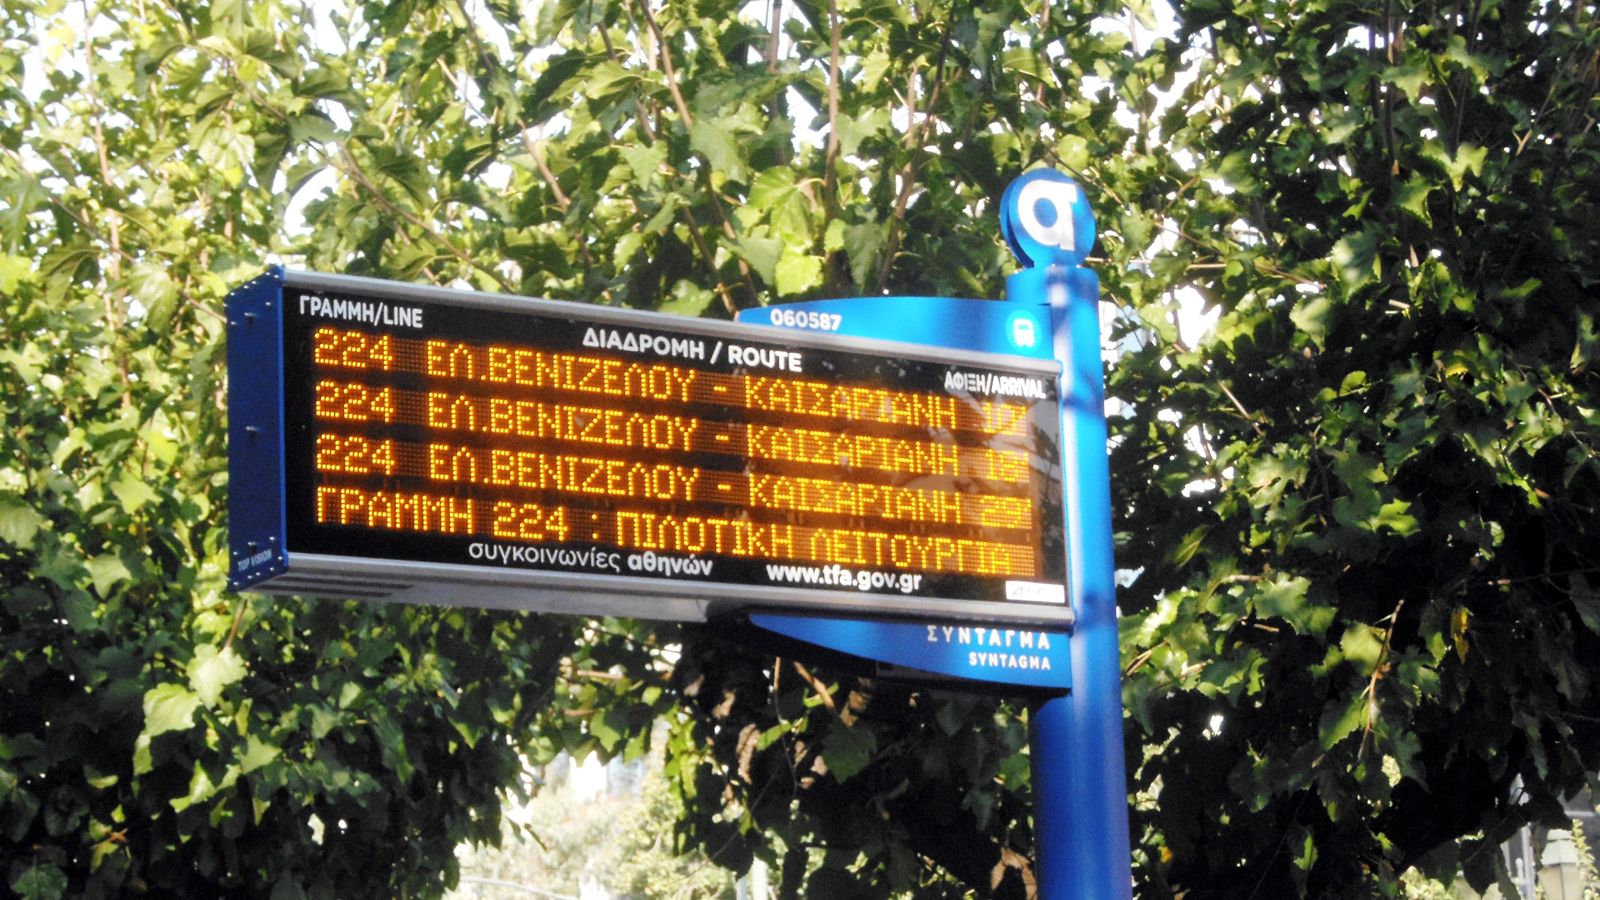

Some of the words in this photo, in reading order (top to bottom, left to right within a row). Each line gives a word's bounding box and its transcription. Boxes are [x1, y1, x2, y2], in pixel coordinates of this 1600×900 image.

[299, 294, 424, 329] ΓΡΑΜΜΗ/LINE
[770, 309, 842, 331] 060587
[582, 327, 706, 361] ΔΙΑΔΡΟΜΗ
[727, 345, 802, 373] ROUTE
[313, 328, 394, 371] 224
[745, 374, 956, 431] ΚΑΙΣΑΡΙΑΝΗ
[943, 371, 1047, 400] ΑΦΙΞΗ/ARRIVAL
[315, 380, 395, 424] 224
[747, 423, 960, 478] ΚΑΙΣΑΡΙΑΝΗ
[315, 433, 396, 477] 224
[749, 472, 962, 526] ΚΑΙΣΑΡΙΑΝΗ
[316, 486, 475, 535] ΓΡΑΜΜΗ
[492, 501, 569, 542] 224
[615, 510, 794, 560] ΠΙΛΟΤΙΚΗ
[468, 540, 622, 573] συγκοινωνίες
[627, 551, 714, 578] αθηνών
[766, 563, 923, 594] www.tfa.gov.gr
[926, 624, 1051, 651] ΣΥΝΤΑΓΜΑ
[968, 651, 1051, 672] SYNTAGMA
